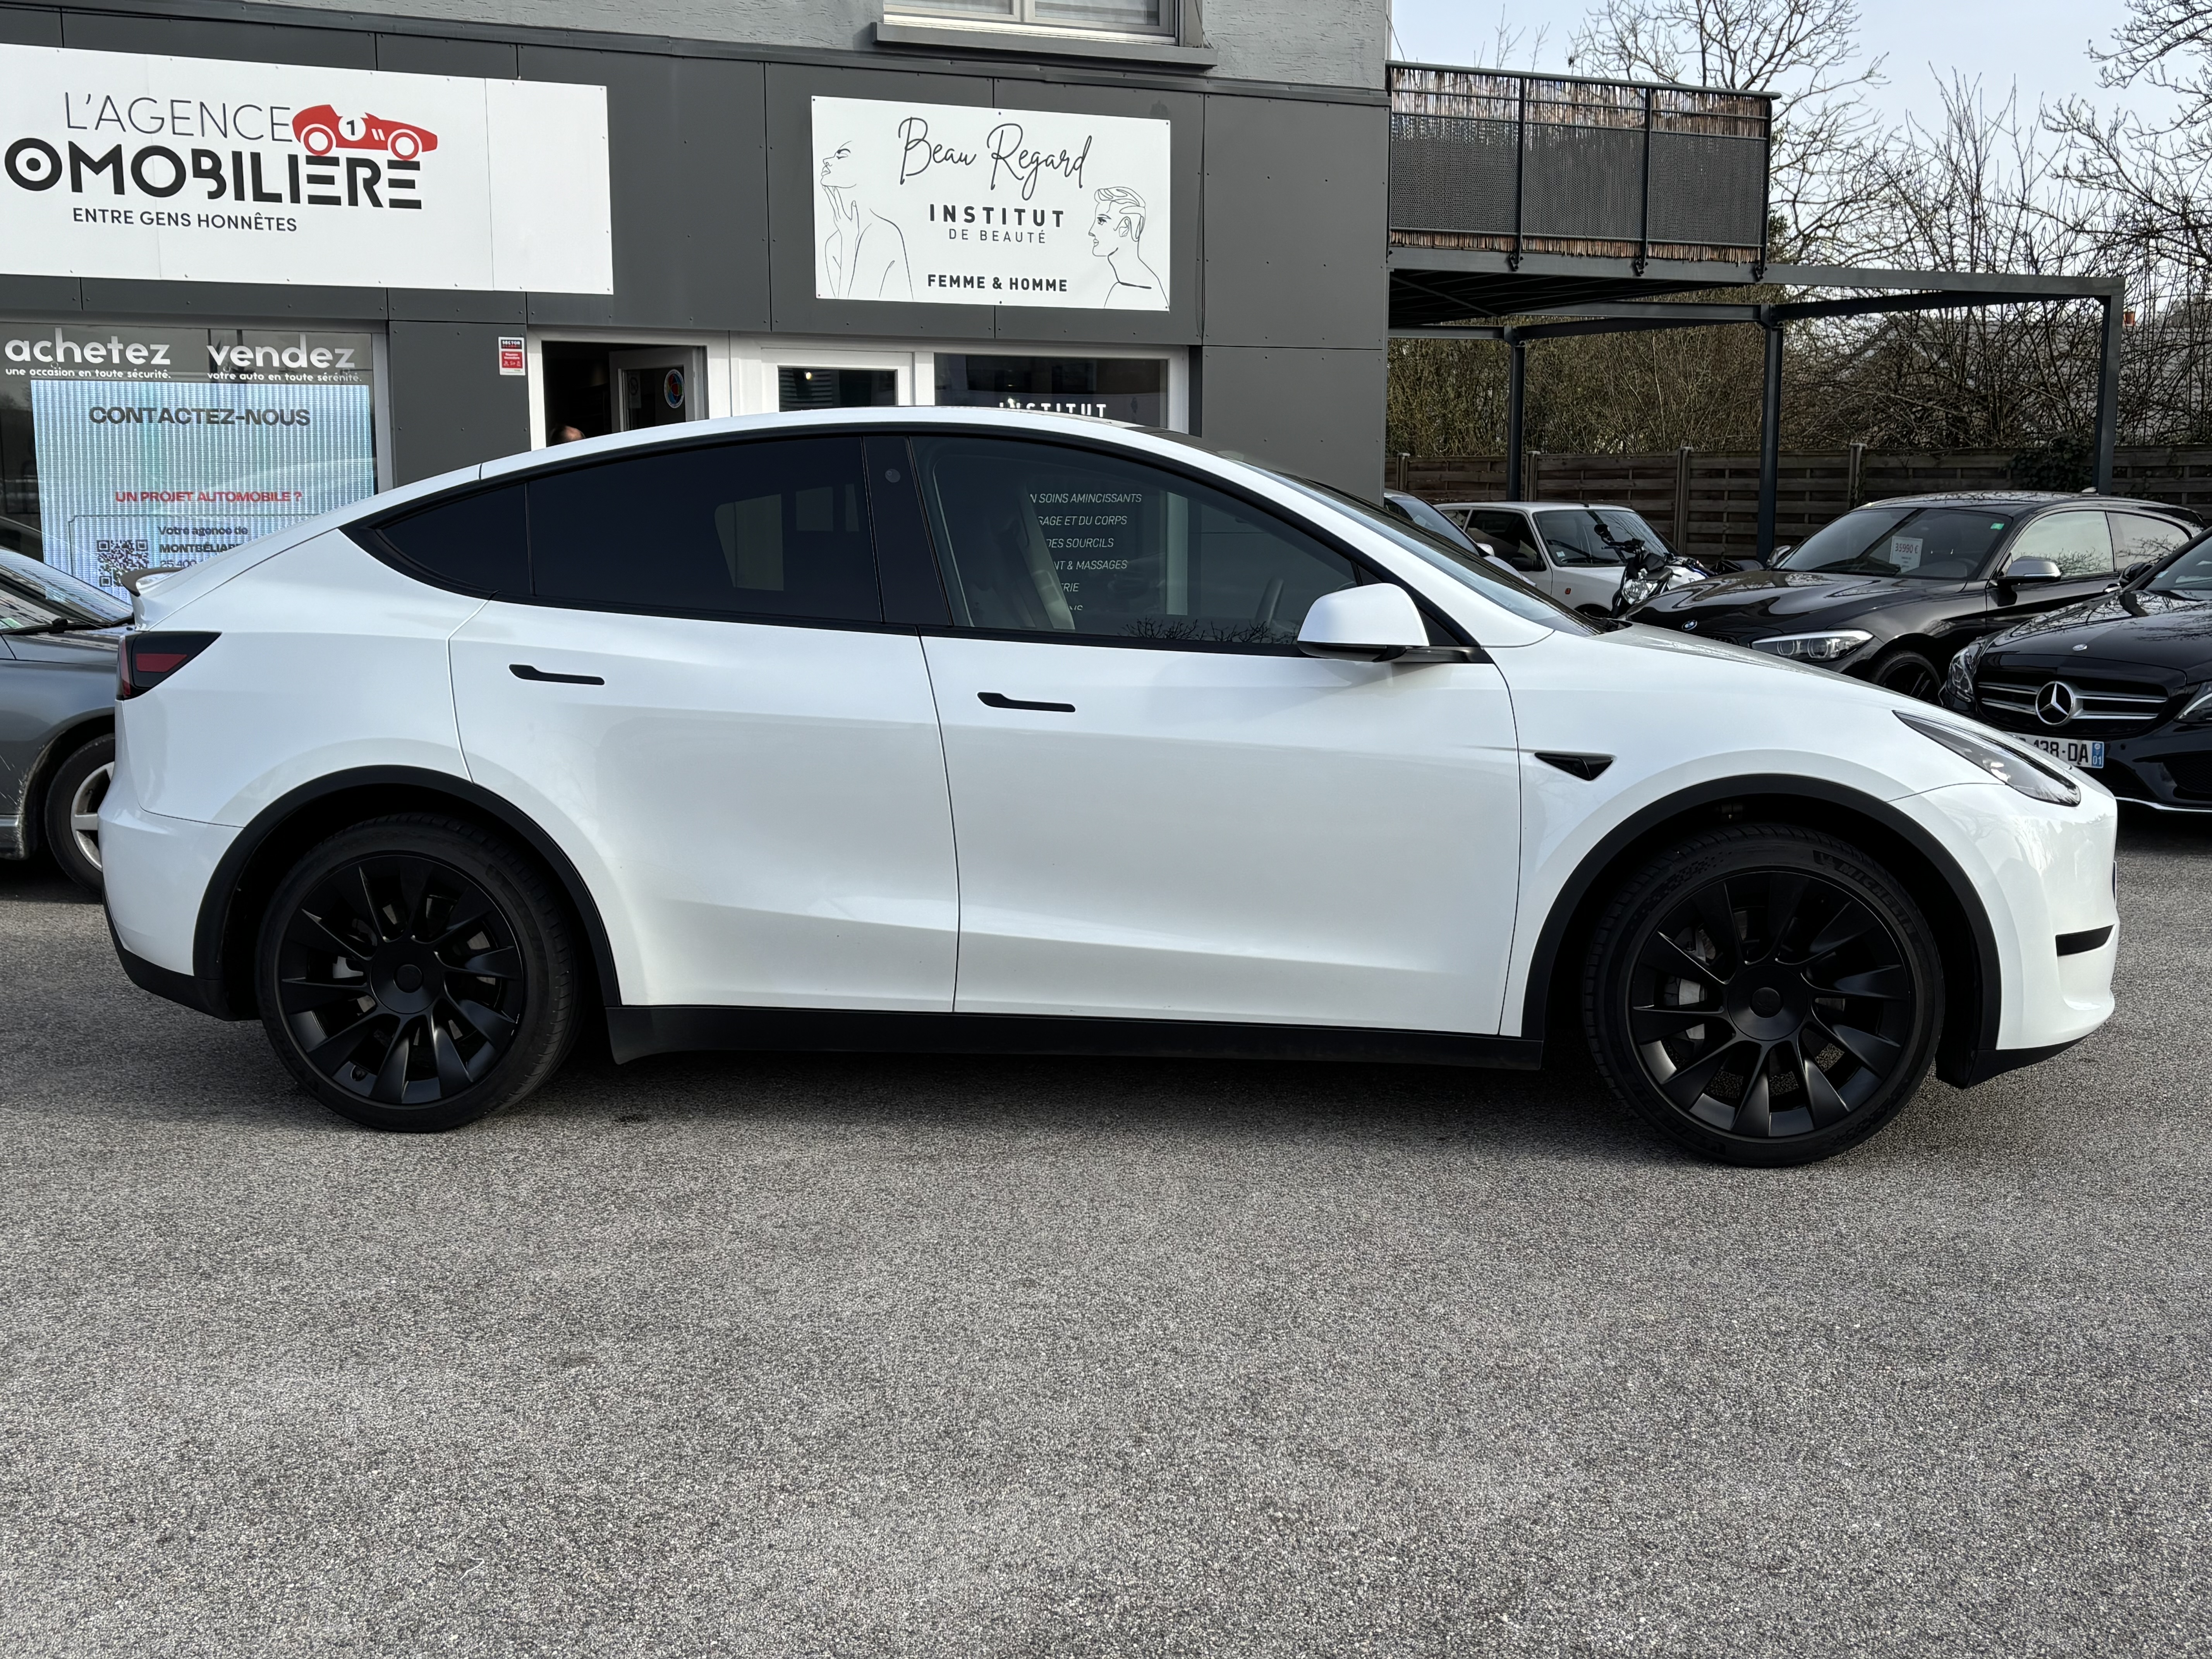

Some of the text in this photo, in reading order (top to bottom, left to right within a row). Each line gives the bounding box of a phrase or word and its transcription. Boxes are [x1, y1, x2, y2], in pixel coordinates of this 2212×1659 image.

[65, 92, 293, 143] L'AGENCE
[347, 120, 355, 136] 1
[898, 117, 1092, 201] Beau Regard
[73, 207, 297, 232] ENTRE GENS HONNÊTES
[930, 204, 1064, 227] INSTITUT
[949, 228, 1046, 244] DE BEAUTÉ
[928, 274, 1067, 292] FEMME & HOMME
[5, 327, 171, 365] achetez
[206, 334, 356, 368] vendez
[5, 368, 172, 379] une occasion en toute sécurité.
[207, 372, 235, 380] votre
[239, 372, 264, 381] auto
[285, 373, 313, 381] toute
[318, 372, 362, 382] sérénité.
[89, 406, 311, 426] CONTACTEZ-NOUS
[116, 491, 302, 502] UN PROJET AUTOMOBILE ?
[1039, 493, 1069, 503] SOINS
[1070, 493, 1142, 503] AMINCISSANTS
[1065, 516, 1078, 526] ET
[1079, 516, 1093, 526] DU
[1095, 515, 1128, 525] CORPS
[158, 526, 190, 535] Votre
[1065, 538, 1114, 548] SOURCILS
[1067, 560, 1073, 570] &
[1076, 560, 1128, 570] MASSAGES
[1061, 582, 1080, 592] RIE
[2092, 755, 2102, 765] 01
